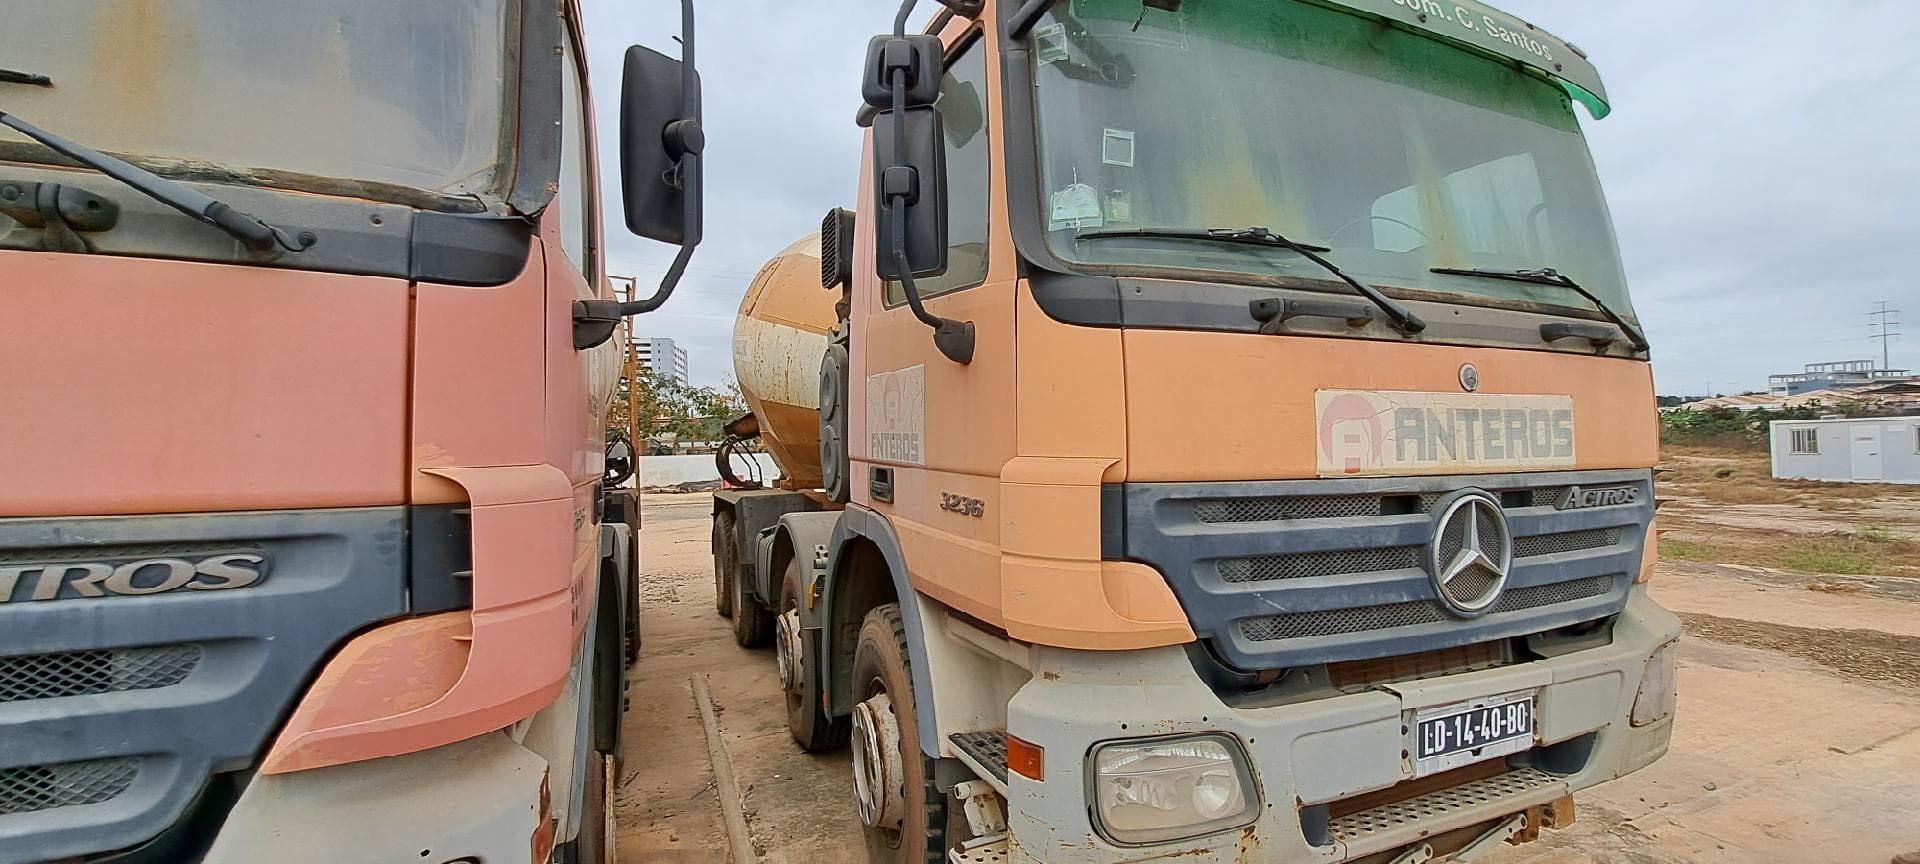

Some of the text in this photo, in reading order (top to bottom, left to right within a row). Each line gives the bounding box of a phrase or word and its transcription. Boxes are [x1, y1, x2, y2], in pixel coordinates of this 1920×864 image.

[1482, 15, 1553, 61] Santos
[1394, 407, 1573, 461] ANTEROS
[940, 491, 985, 518] 3236
[1424, 703, 1528, 756] LD-14-40-BQ
